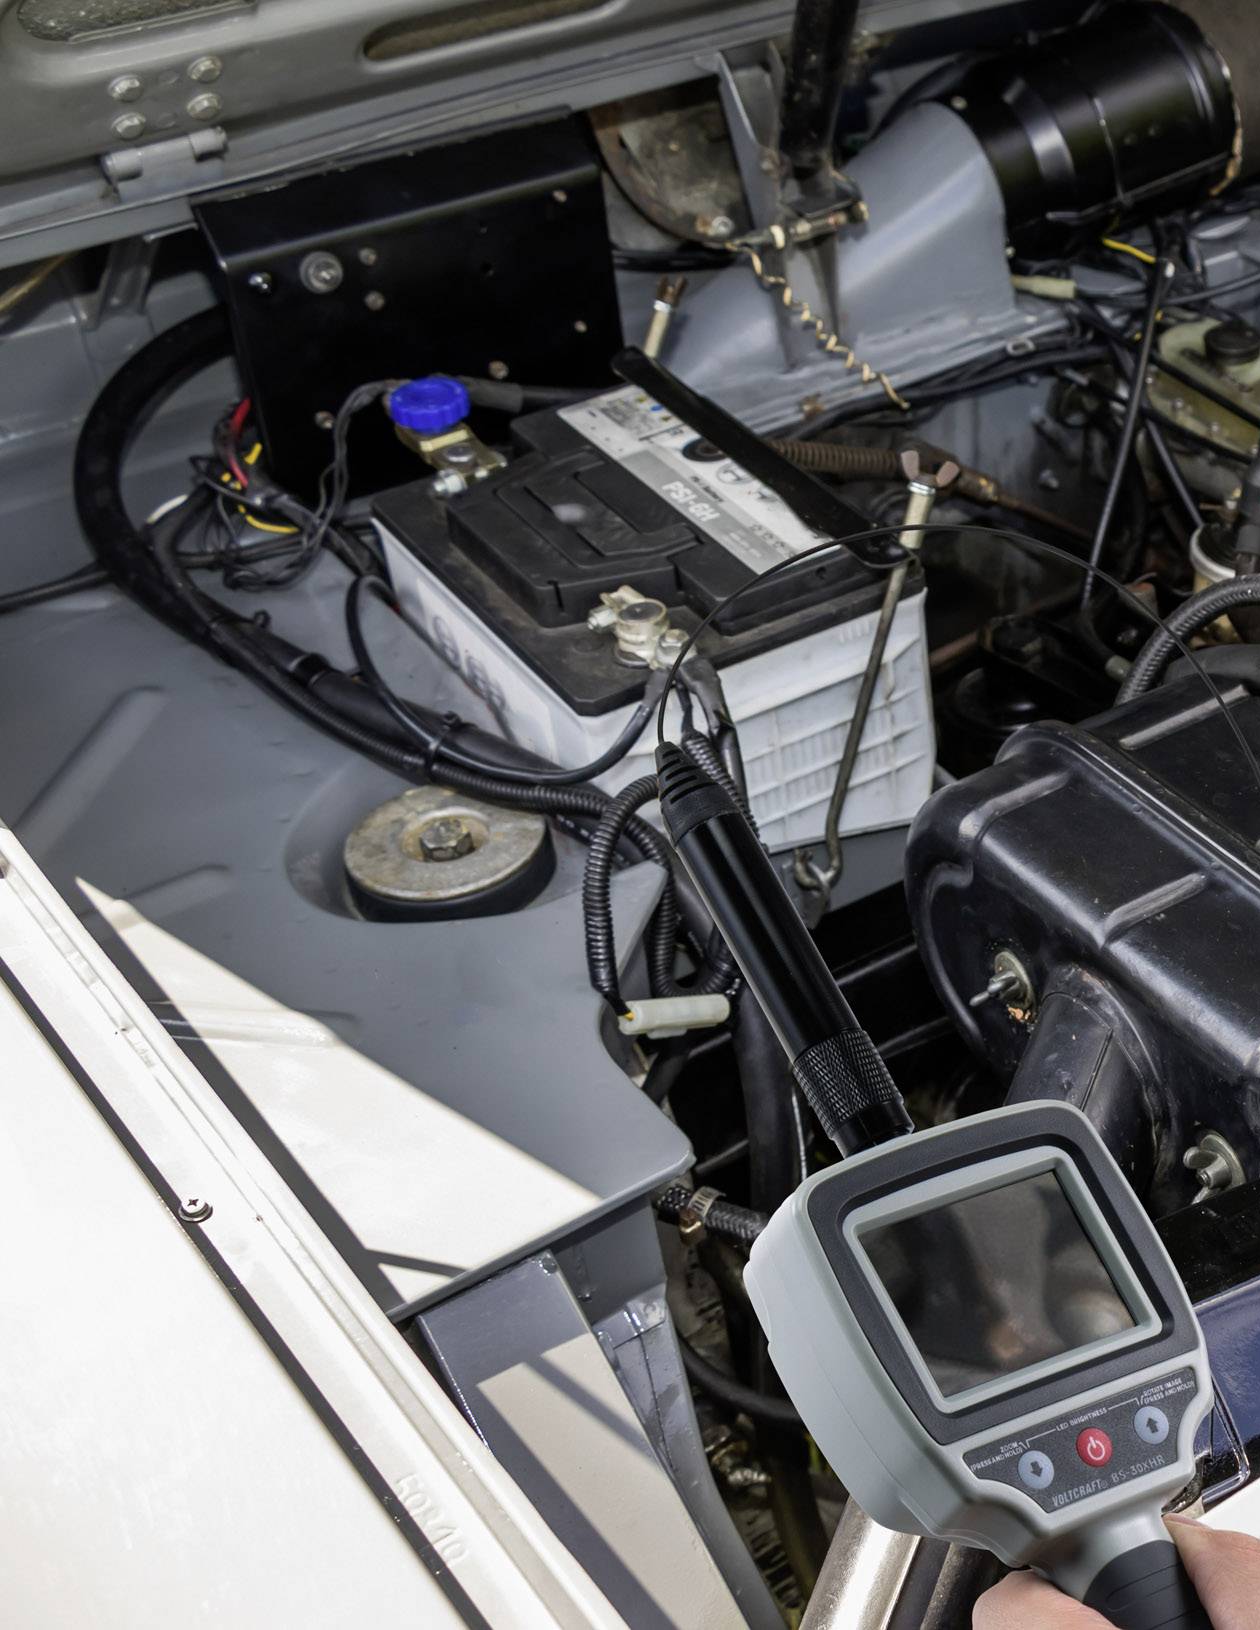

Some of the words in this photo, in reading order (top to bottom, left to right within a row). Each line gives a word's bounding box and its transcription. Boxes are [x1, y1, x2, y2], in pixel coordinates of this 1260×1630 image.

[1143, 1384, 1164, 1397] ROTATE
[1164, 1377, 1182, 1389] IMAGE
[1056, 1422, 1069, 1431] LED
[1069, 1407, 1107, 1426] BRIGHTNESS
[1000, 1441, 1018, 1453] ZOOM
[970, 1458, 992, 1472] (PRESS
[991, 1453, 1005, 1464] AND
[1111, 1454, 1166, 1482] BS-30XHR
